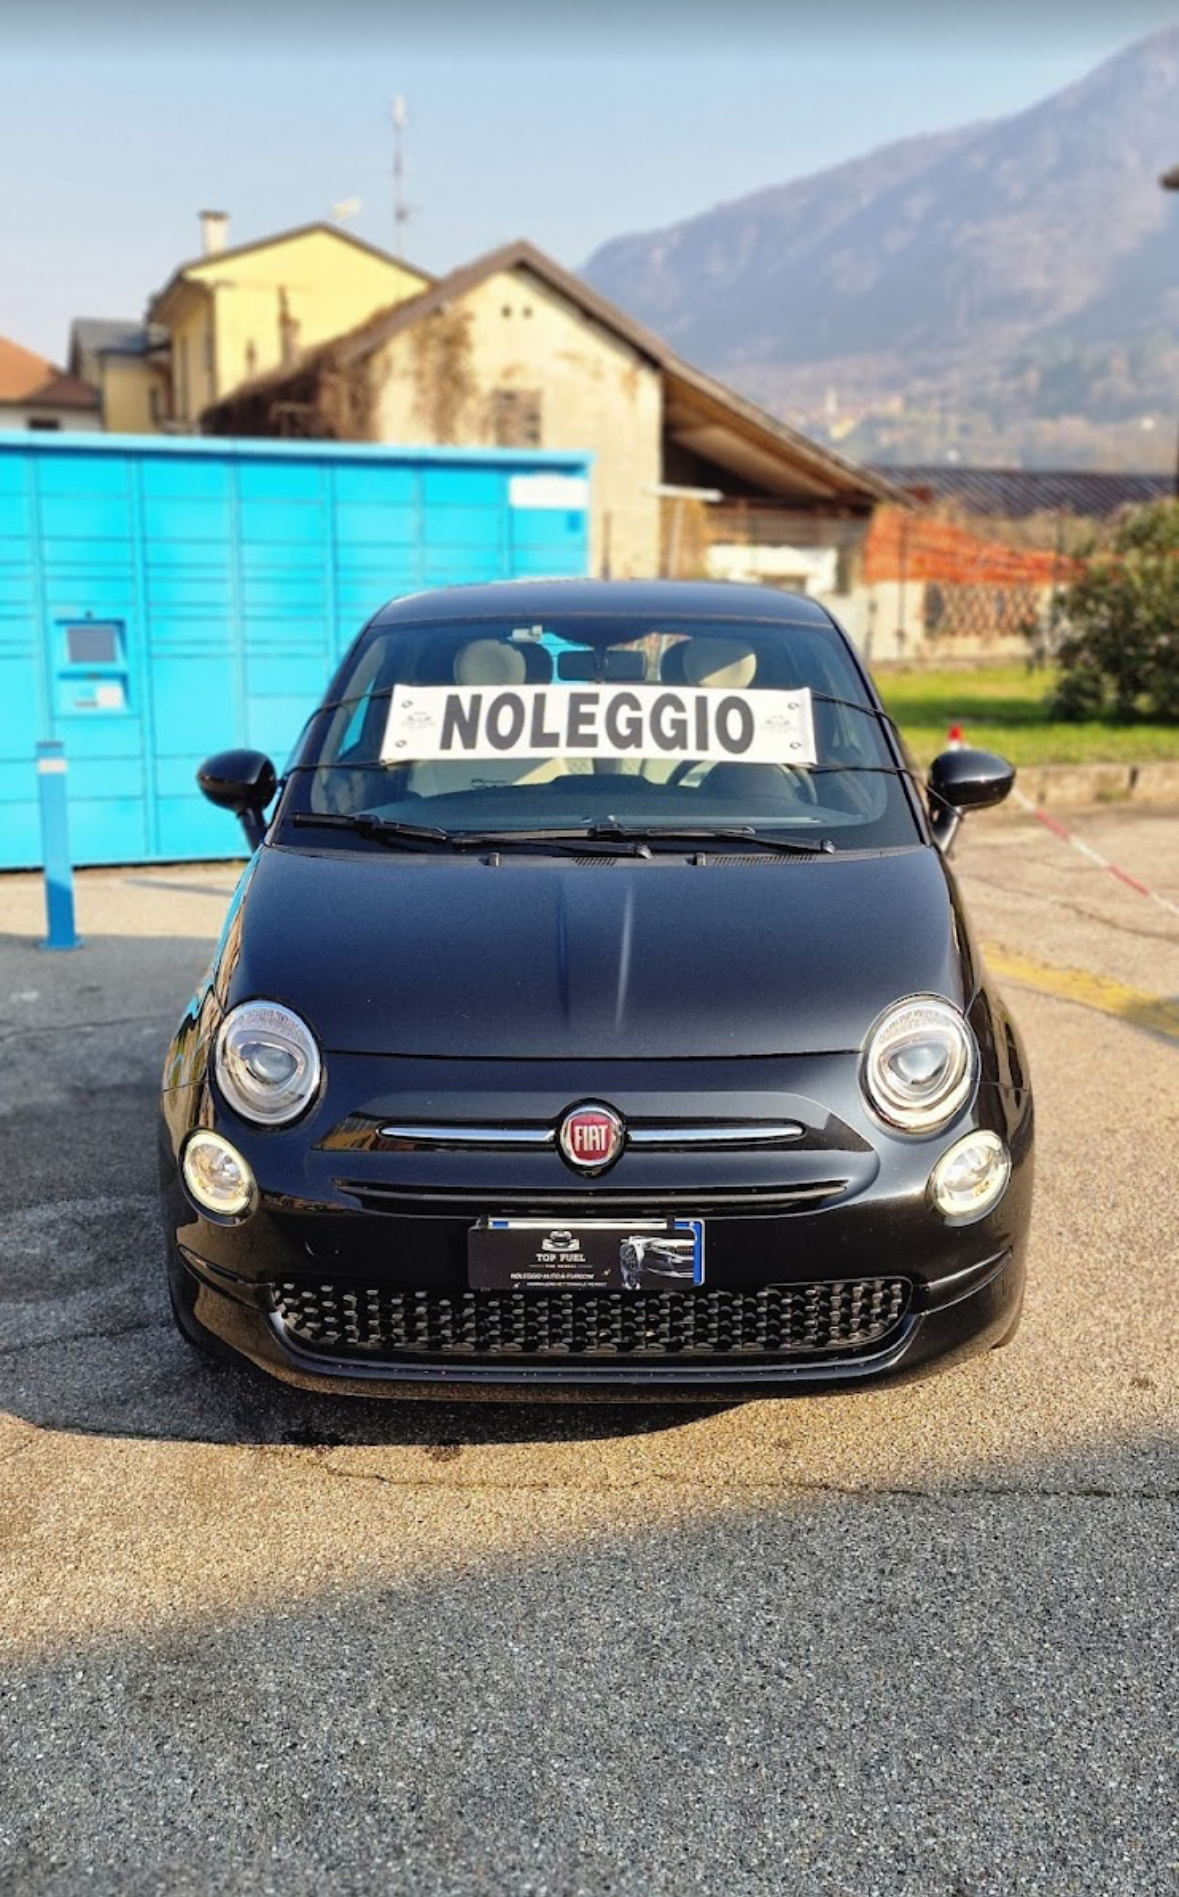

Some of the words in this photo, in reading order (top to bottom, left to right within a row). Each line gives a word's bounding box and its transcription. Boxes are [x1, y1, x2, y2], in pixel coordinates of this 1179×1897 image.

[439, 691, 755, 755] NOLEGGIO
[574, 1125, 609, 1152] FIAT
[536, 1253, 556, 1262] TOP
[560, 1253, 586, 1262] FUEL
